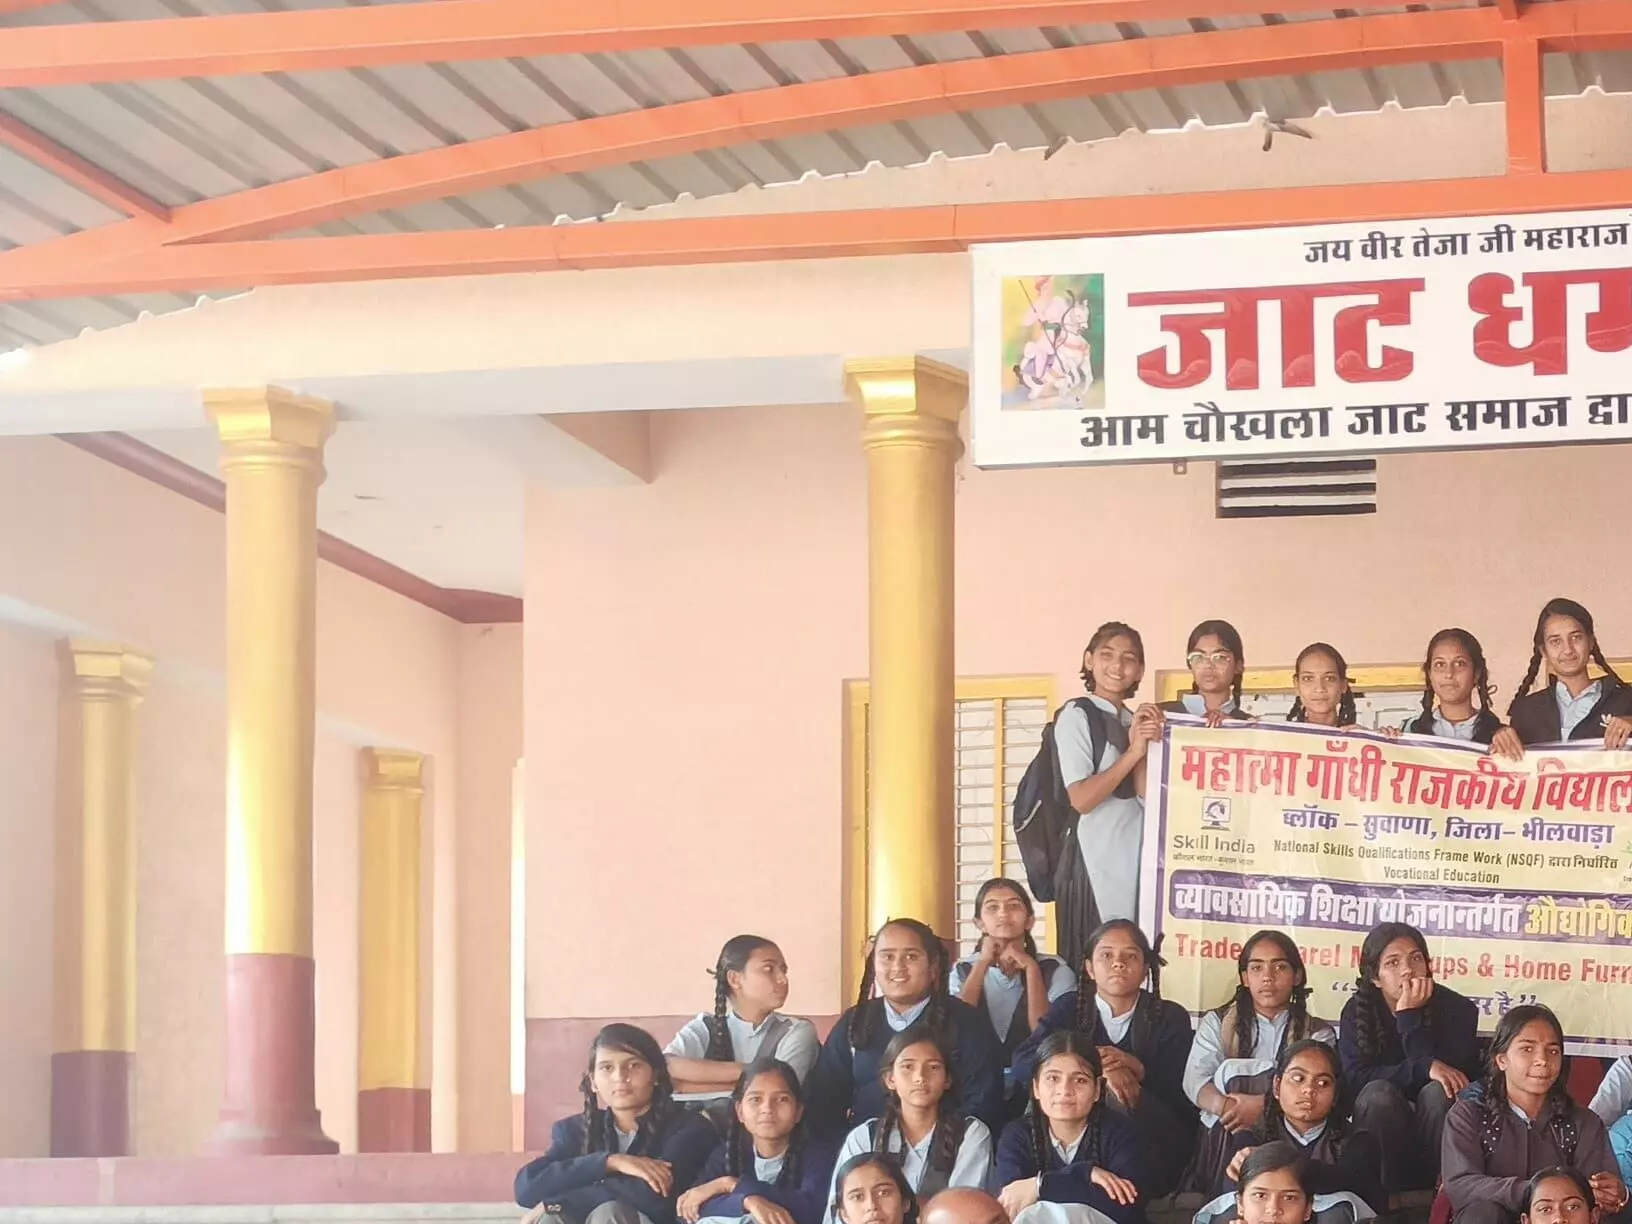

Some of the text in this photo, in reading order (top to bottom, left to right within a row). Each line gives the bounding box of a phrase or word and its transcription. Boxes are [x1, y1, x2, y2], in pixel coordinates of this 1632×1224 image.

[1304, 223, 1630, 263] जय वीर तेजा जी महाराज
[1128, 276, 1426, 391] जाट
[1080, 413, 1169, 448] आम
[1345, 402, 1429, 435] जाट
[1445, 396, 1572, 432] समाज
[1181, 746, 1301, 796] महात्मा
[1306, 740, 1386, 802] गाँधी
[1391, 757, 1530, 811] राजकीय
[1173, 834, 1256, 854] Skill India
[1522, 817, 1616, 849] भीलवाड़ा
[1273, 839, 1545, 869] National Skills Qualifications Frame Work (NSQF)
[1384, 866, 1500, 884] Vocational Education
[1309, 883, 1376, 926] शिक्षा
[1477, 954, 1494, 977] &
[1504, 954, 1571, 982] Home
